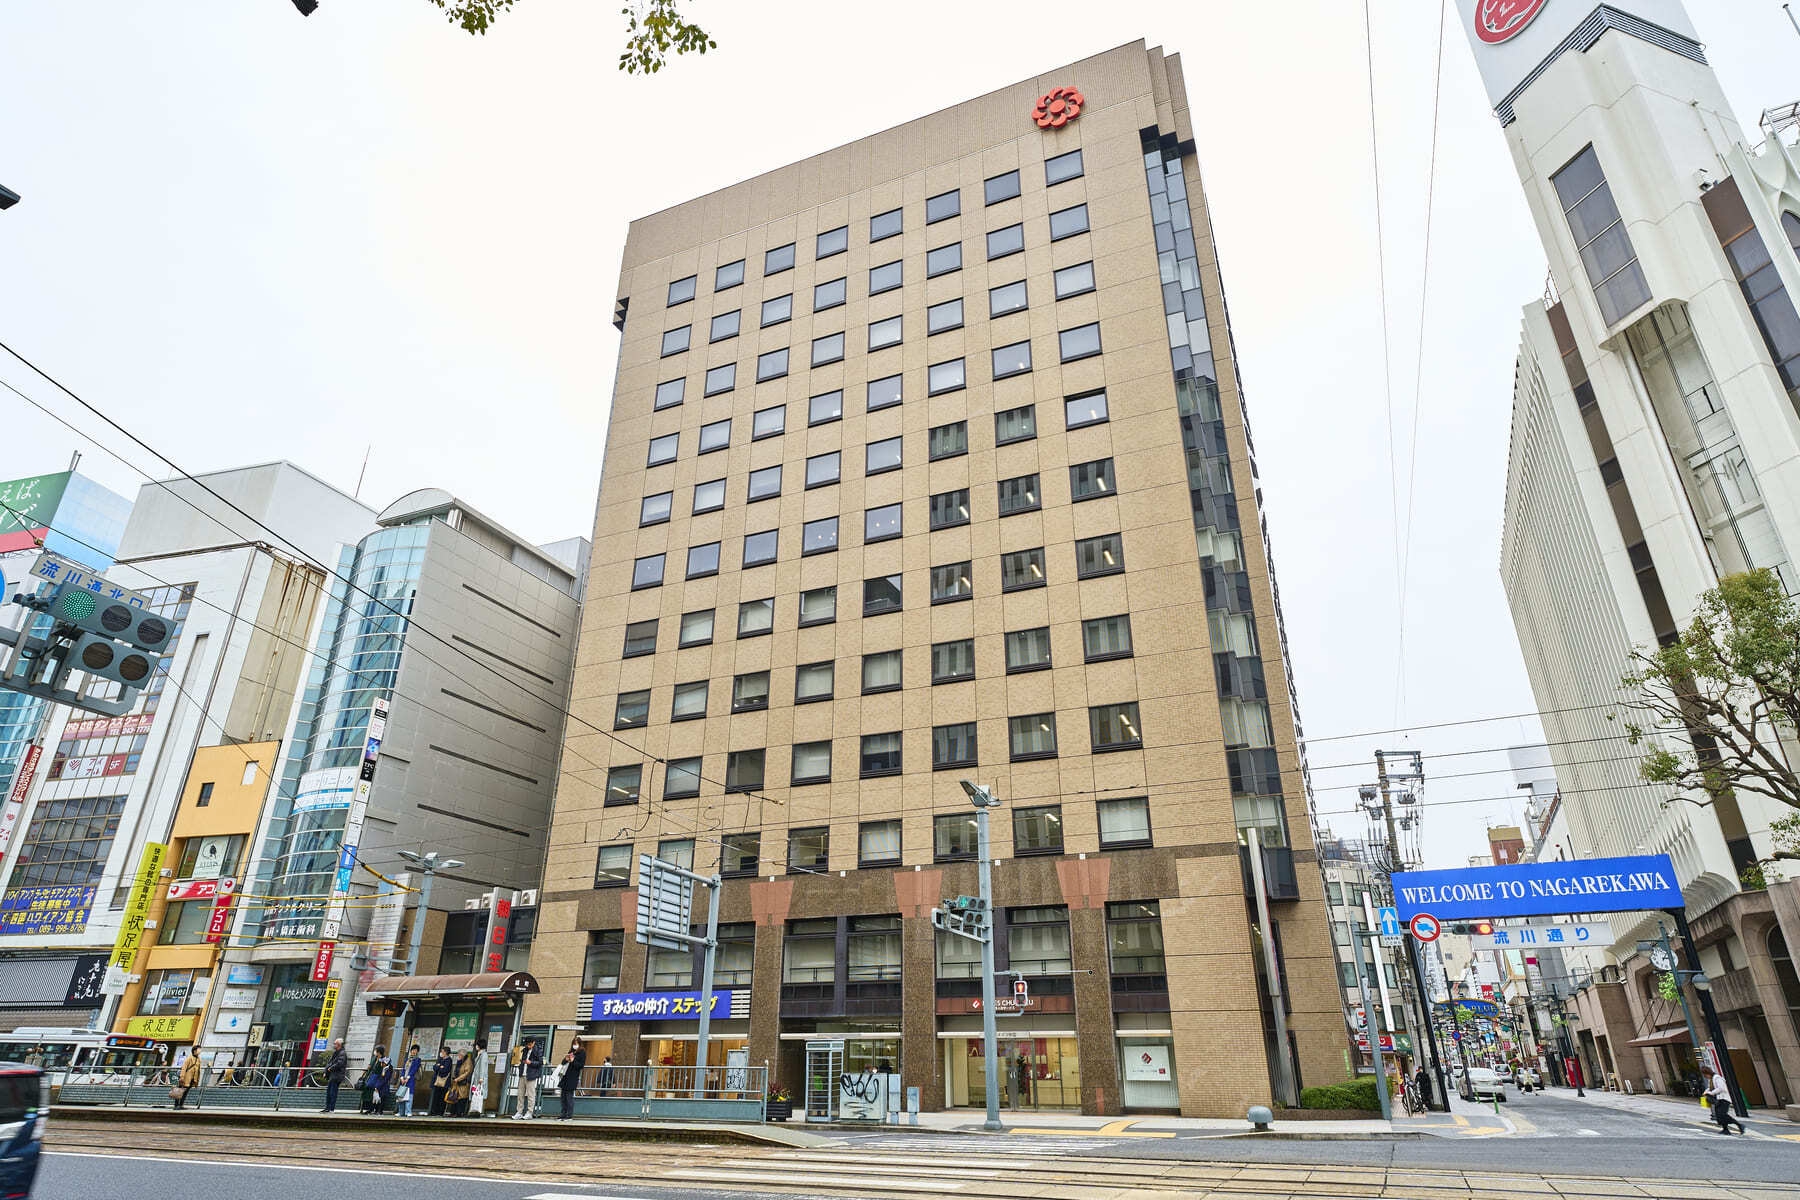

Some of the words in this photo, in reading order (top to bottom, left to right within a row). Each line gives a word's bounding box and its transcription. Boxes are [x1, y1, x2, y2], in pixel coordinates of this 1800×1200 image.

[39, 560, 143, 608] 流川通北口
[199, 884, 218, 895] アコ
[1401, 883, 1493, 905] WELCOME
[1497, 880, 1525, 899] TO
[1528, 871, 1670, 897] NAGAREKAWA
[212, 906, 226, 932] アコム
[1494, 926, 1591, 945] 流川通り
[602, 998, 669, 1016] すみふの仲介
